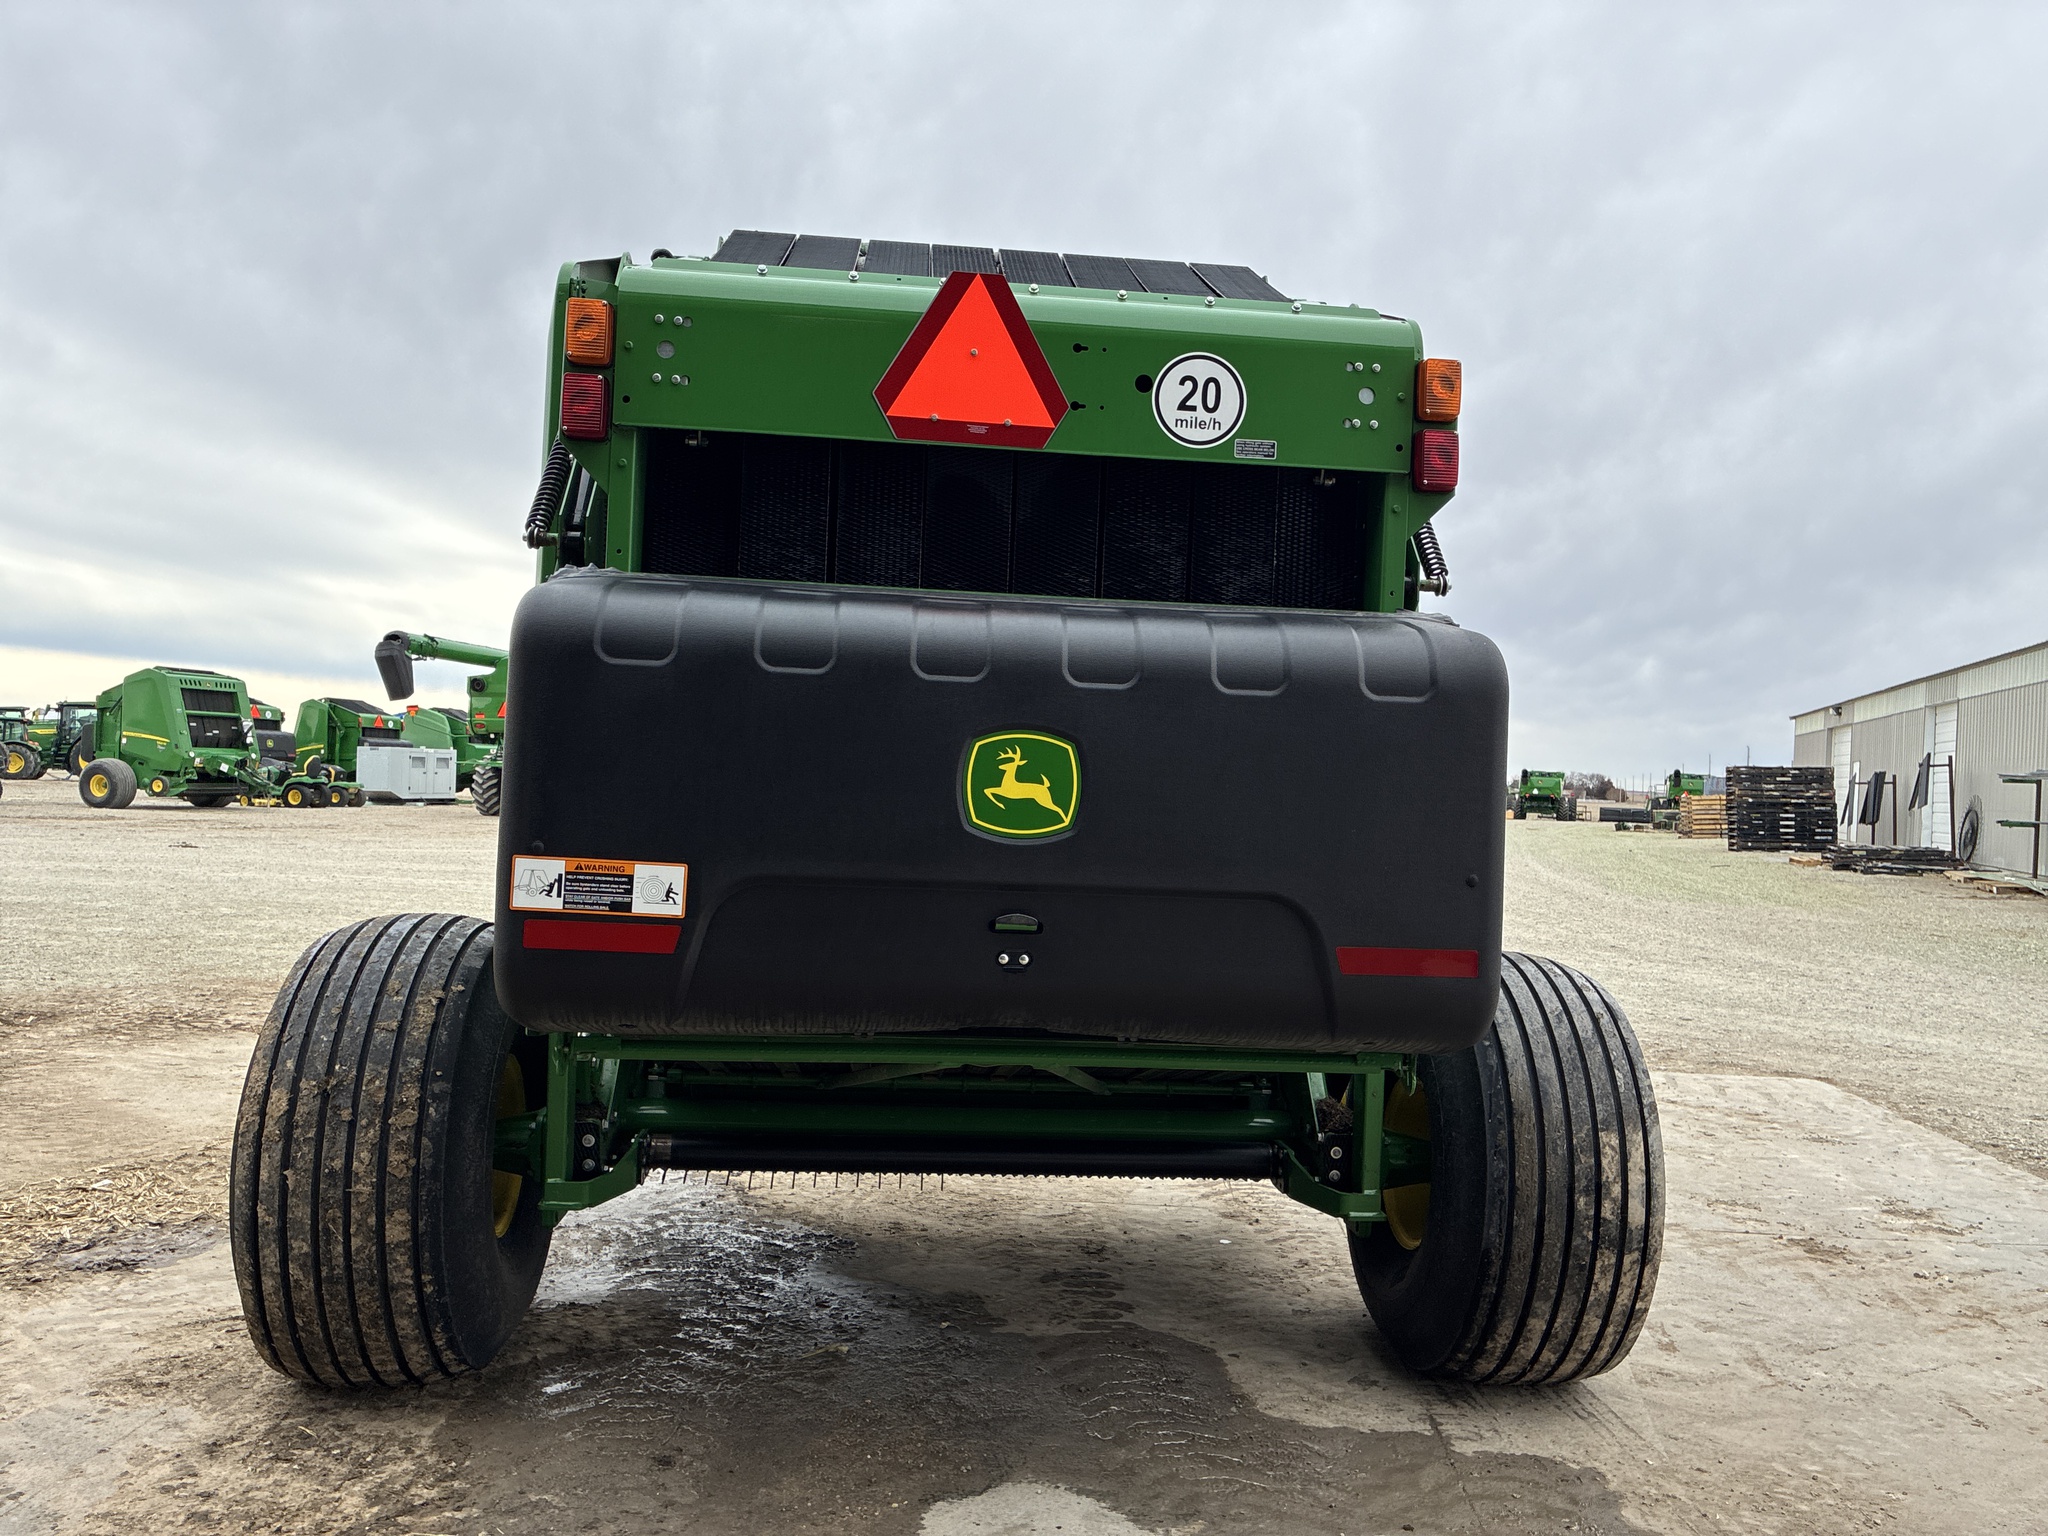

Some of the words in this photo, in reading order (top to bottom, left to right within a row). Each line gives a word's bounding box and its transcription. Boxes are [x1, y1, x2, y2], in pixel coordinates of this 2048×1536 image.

[1177, 375, 1221, 413] 20
[1175, 416, 1221, 431] mile/h
[584, 864, 625, 873] WARNING
